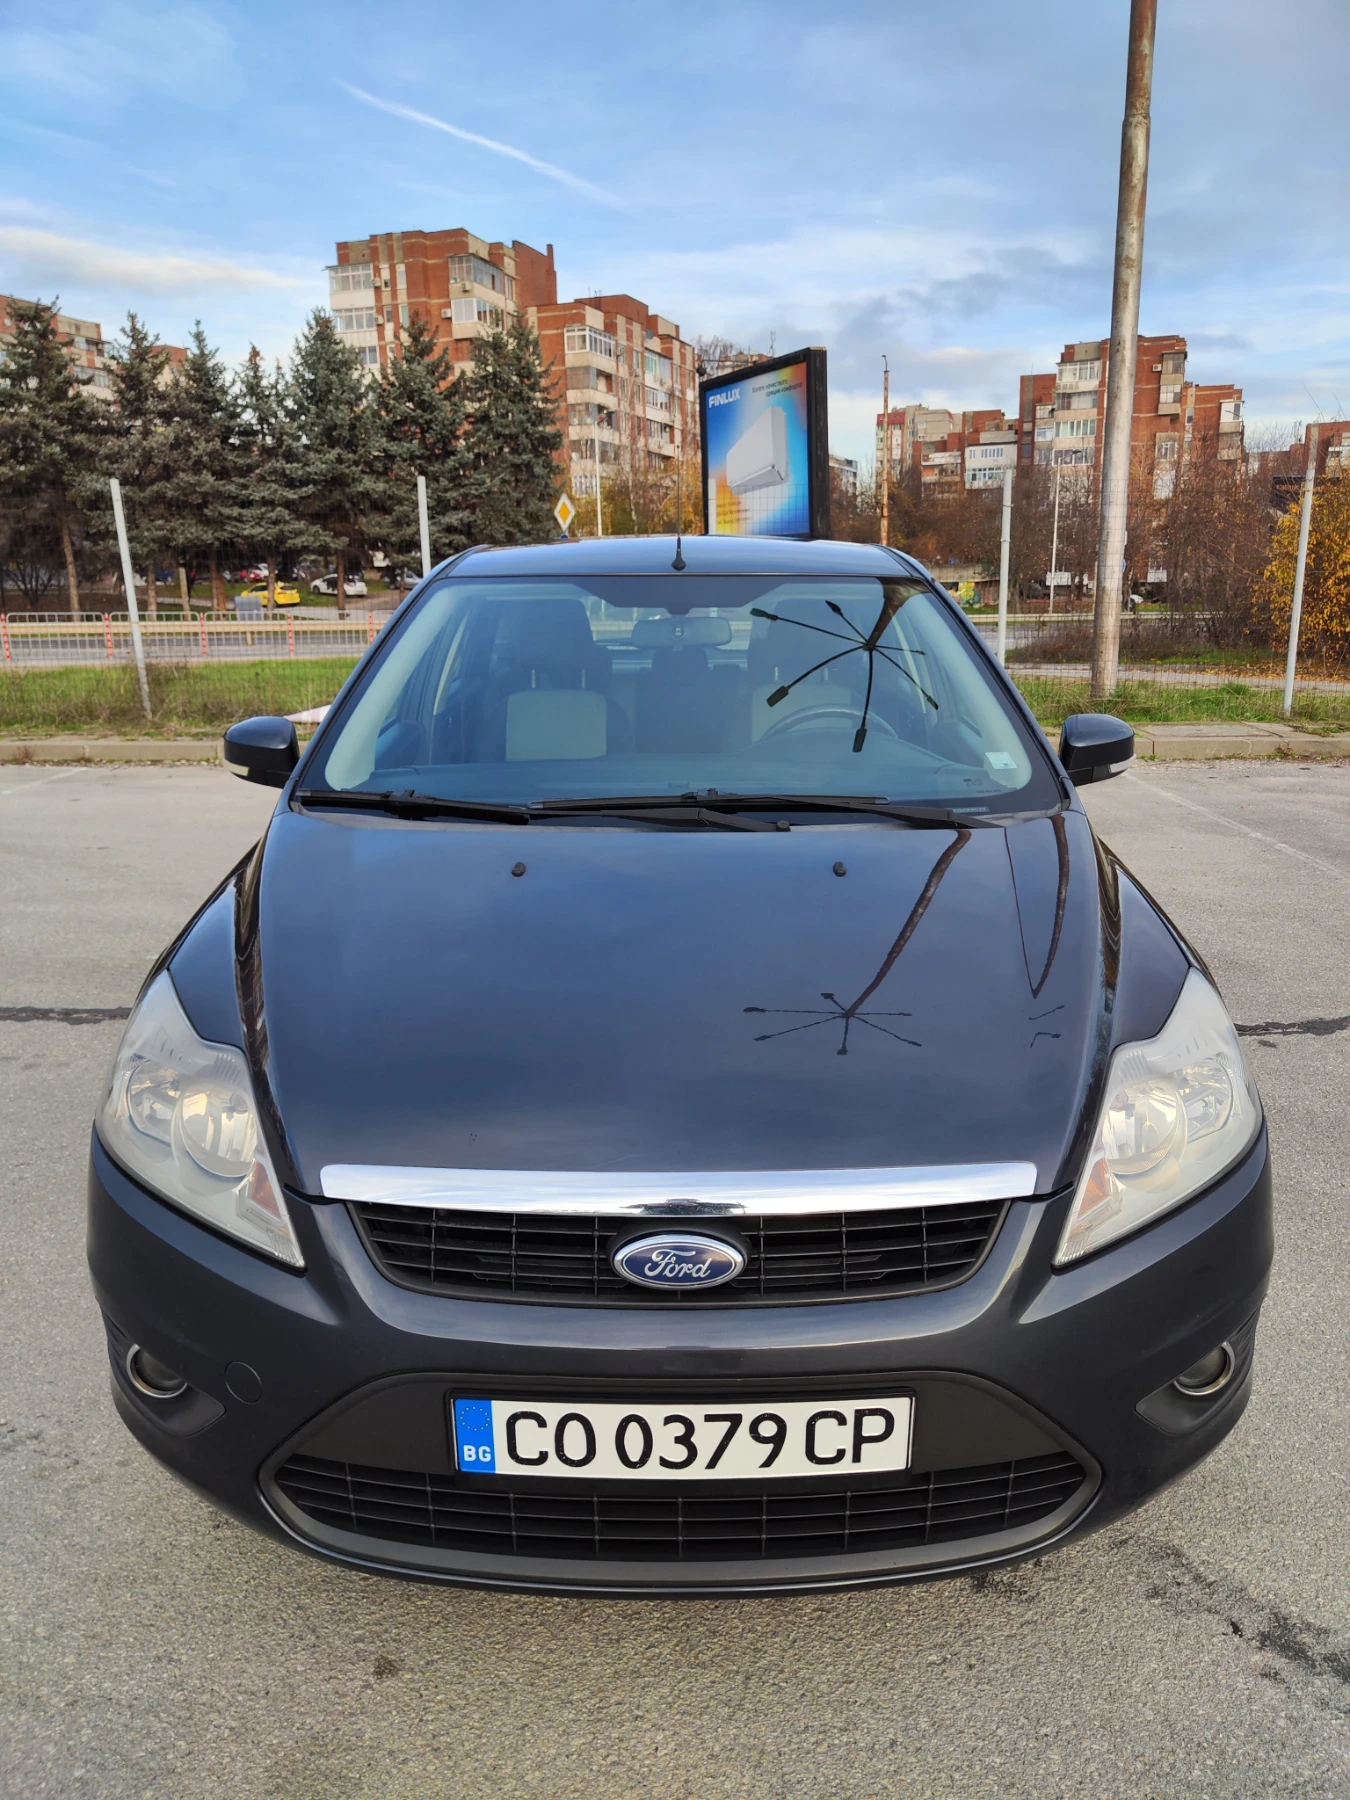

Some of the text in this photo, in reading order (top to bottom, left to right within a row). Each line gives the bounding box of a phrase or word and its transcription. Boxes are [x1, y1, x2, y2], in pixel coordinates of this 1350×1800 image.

[708, 388, 741, 408] FINLUX
[644, 1249, 711, 1278] Ford
[506, 1408, 896, 1470] CO 0379 CP
[463, 1445, 492, 1463] BG
